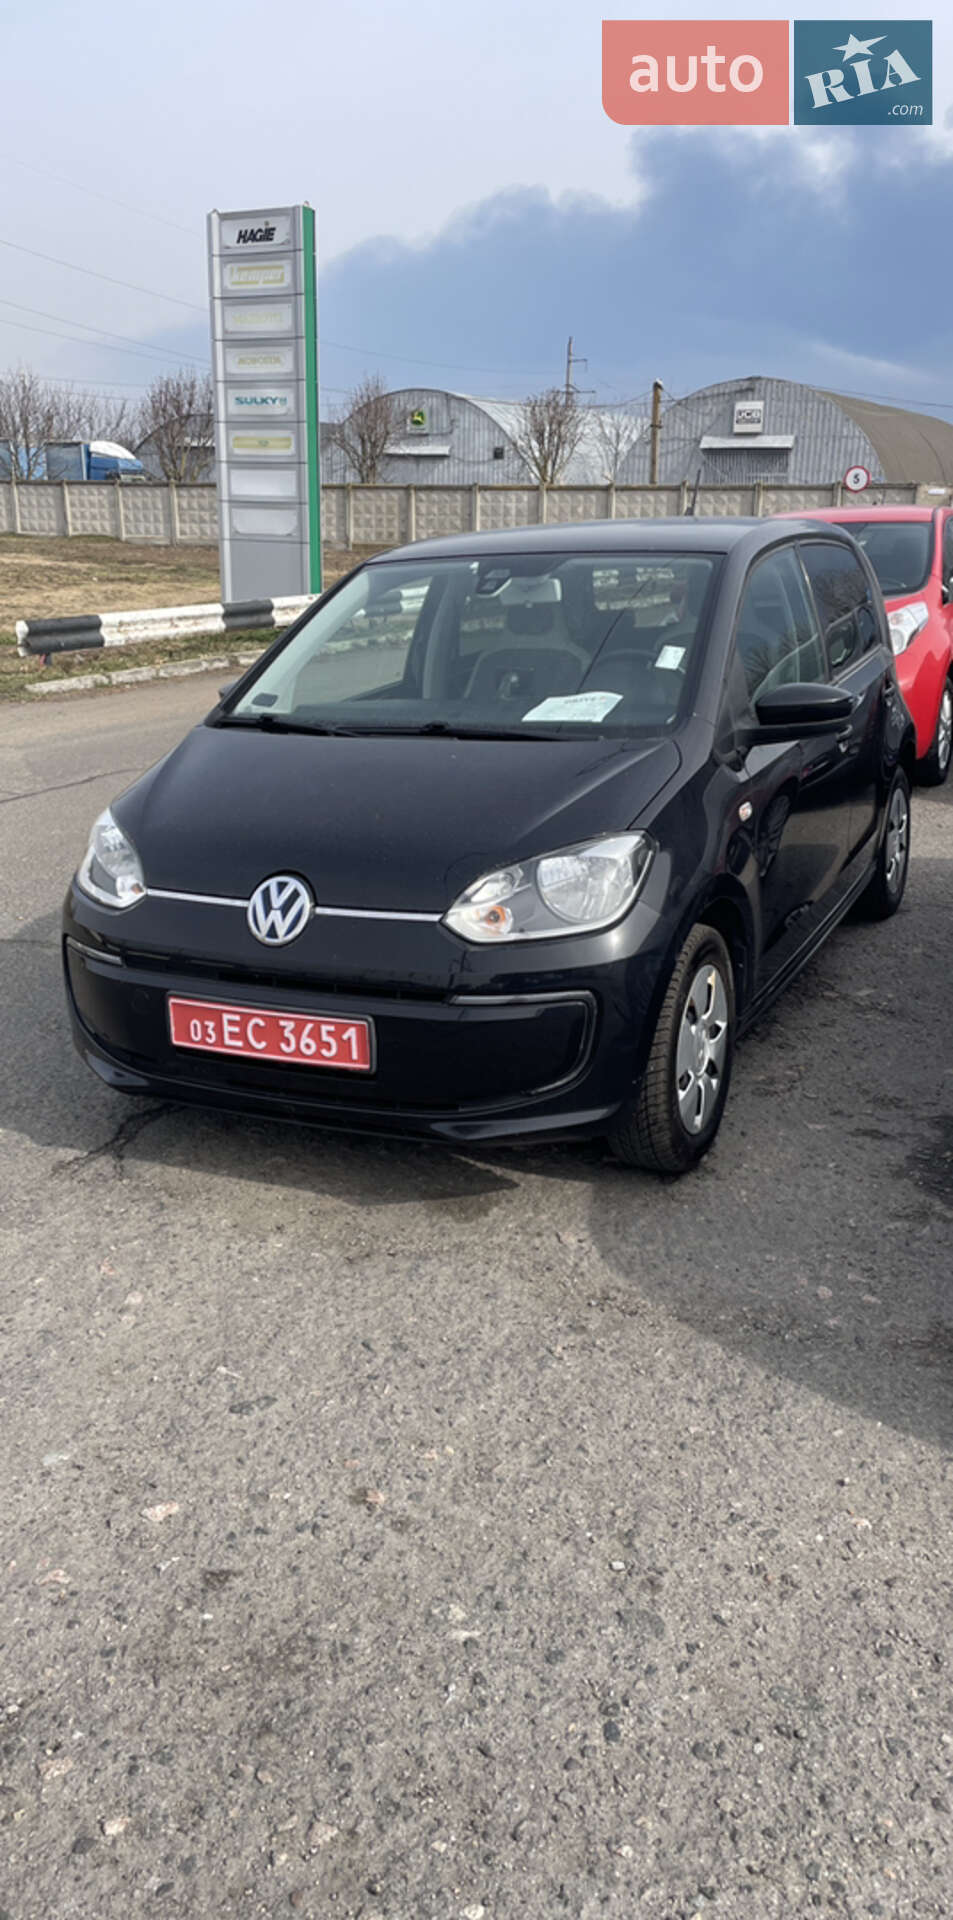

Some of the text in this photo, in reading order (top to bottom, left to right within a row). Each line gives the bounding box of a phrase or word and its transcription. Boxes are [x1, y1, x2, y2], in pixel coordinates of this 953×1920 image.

[236, 227, 276, 244] HAGIE
[235, 396, 279, 405] SULKY
[853, 473, 860, 484] 5
[279, 1019, 359, 1061] 3651
